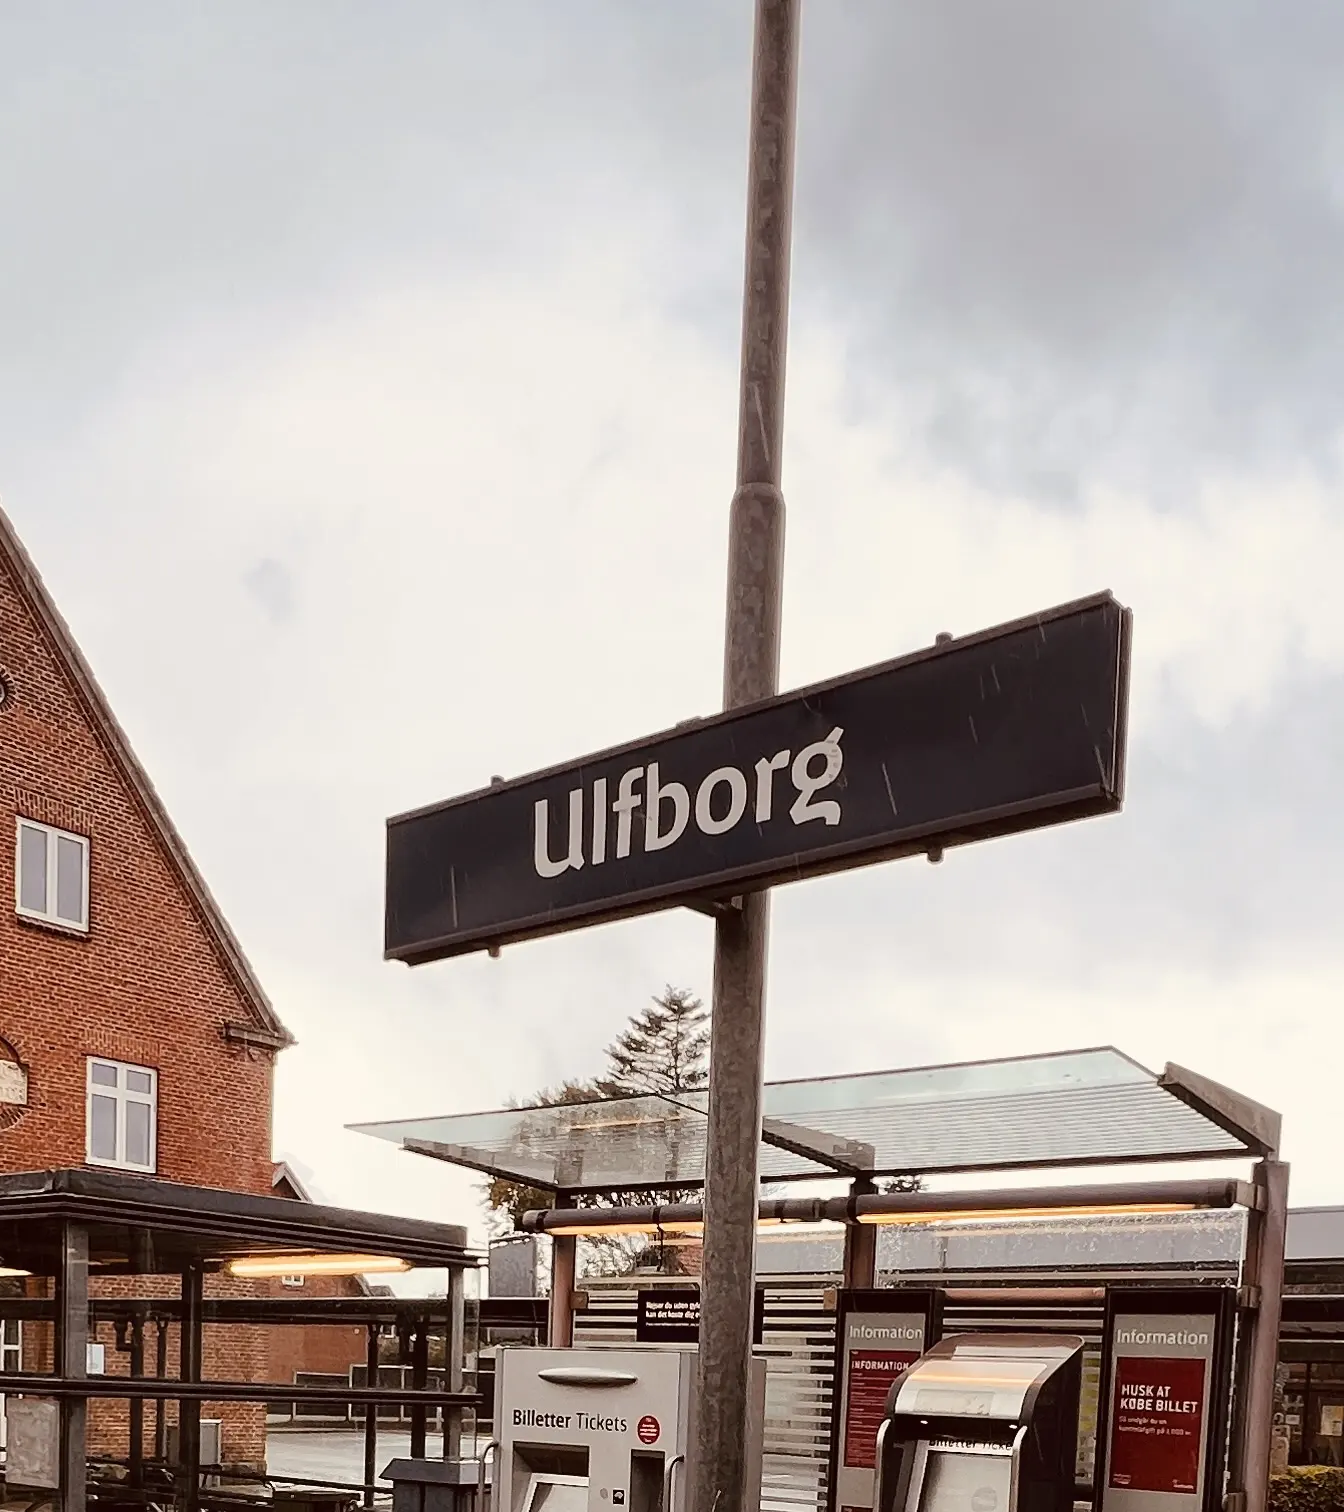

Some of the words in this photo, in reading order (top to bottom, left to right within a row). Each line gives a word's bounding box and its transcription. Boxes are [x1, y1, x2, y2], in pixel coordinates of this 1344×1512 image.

[533, 726, 845, 878] Ulfborg
[849, 1325, 923, 1339] Information
[1117, 1329, 1208, 1345] Information
[1121, 1384, 1155, 1397] HUSK
[1156, 1386, 1172, 1398] AT
[1120, 1397, 1153, 1411] KØBE
[1156, 1399, 1198, 1414] BILLET
[512, 1409, 572, 1428] Billetter
[576, 1412, 628, 1432] Tickets
